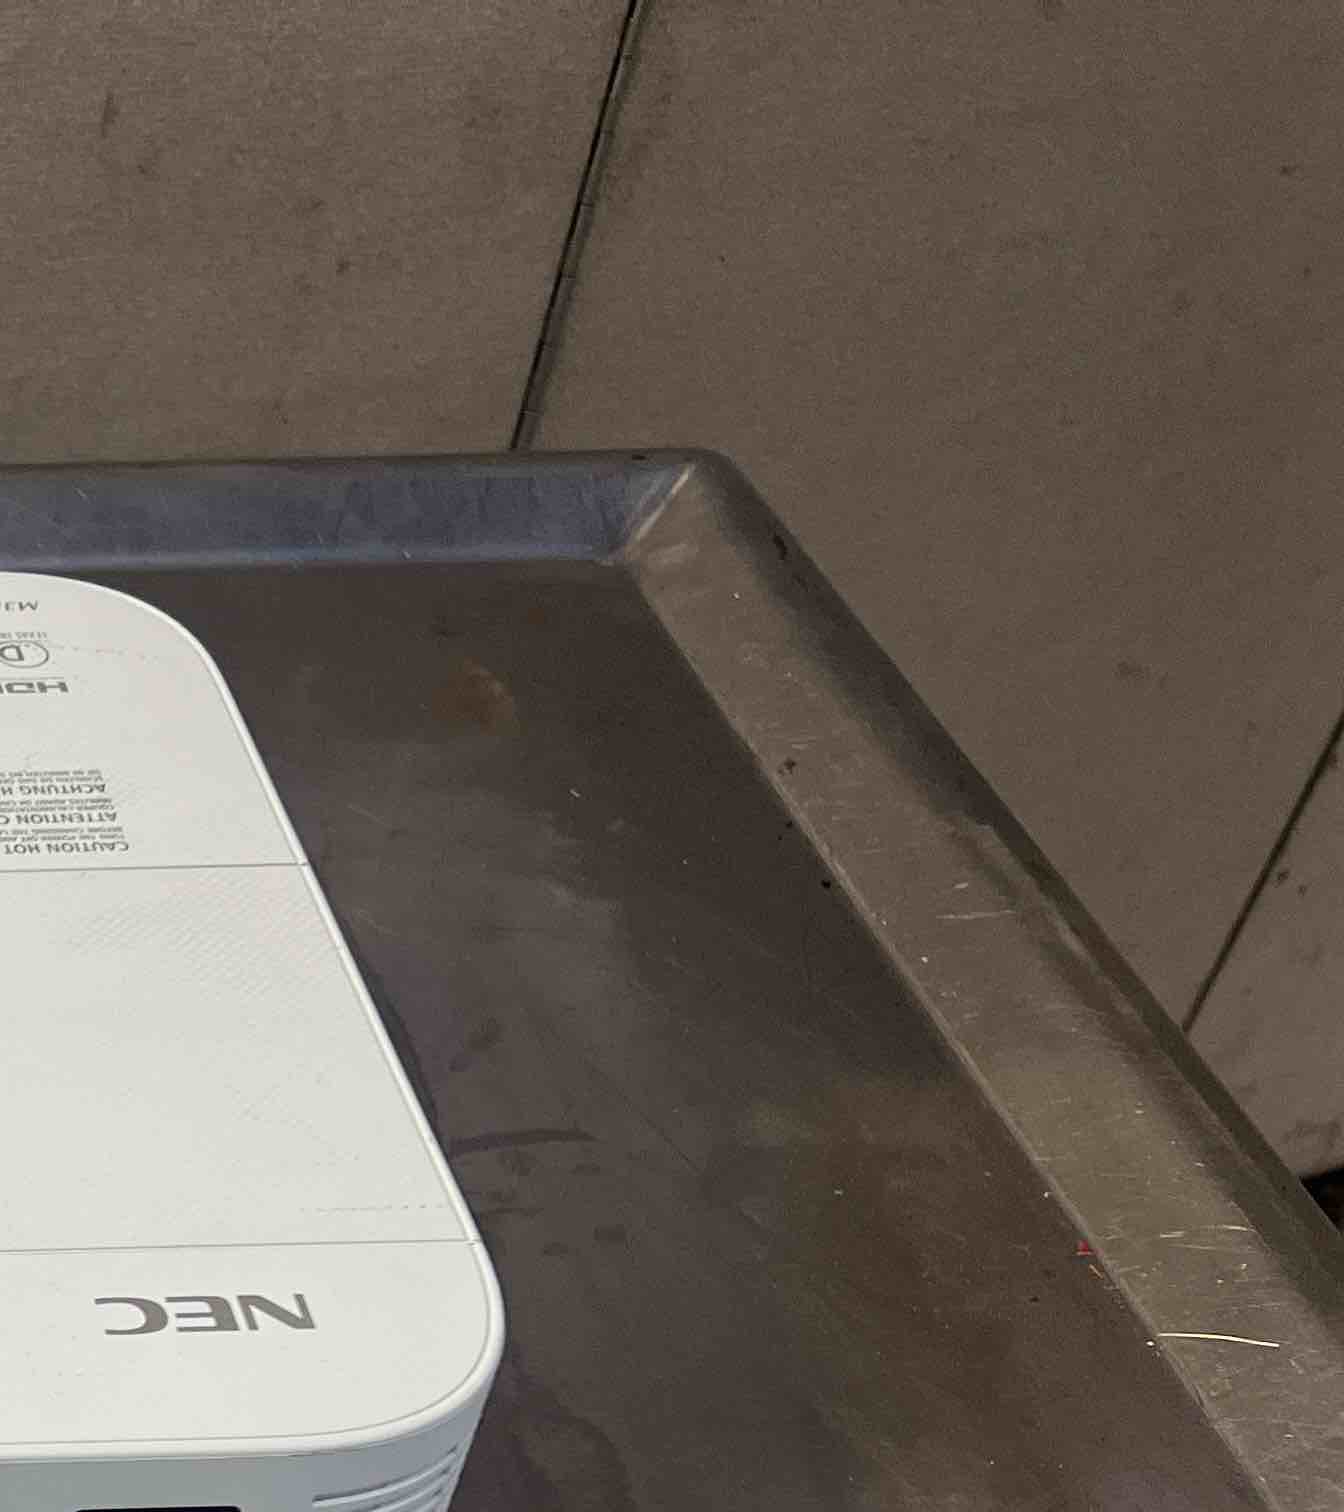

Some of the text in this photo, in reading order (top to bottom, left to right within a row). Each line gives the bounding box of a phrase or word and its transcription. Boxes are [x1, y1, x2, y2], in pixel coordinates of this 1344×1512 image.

[19, 782, 106, 796] ACHTUNG
[16, 811, 118, 826] ATTENTION
[4, 840, 130, 856] CAUTION HOT
[93, 1292, 317, 1337] NEC
